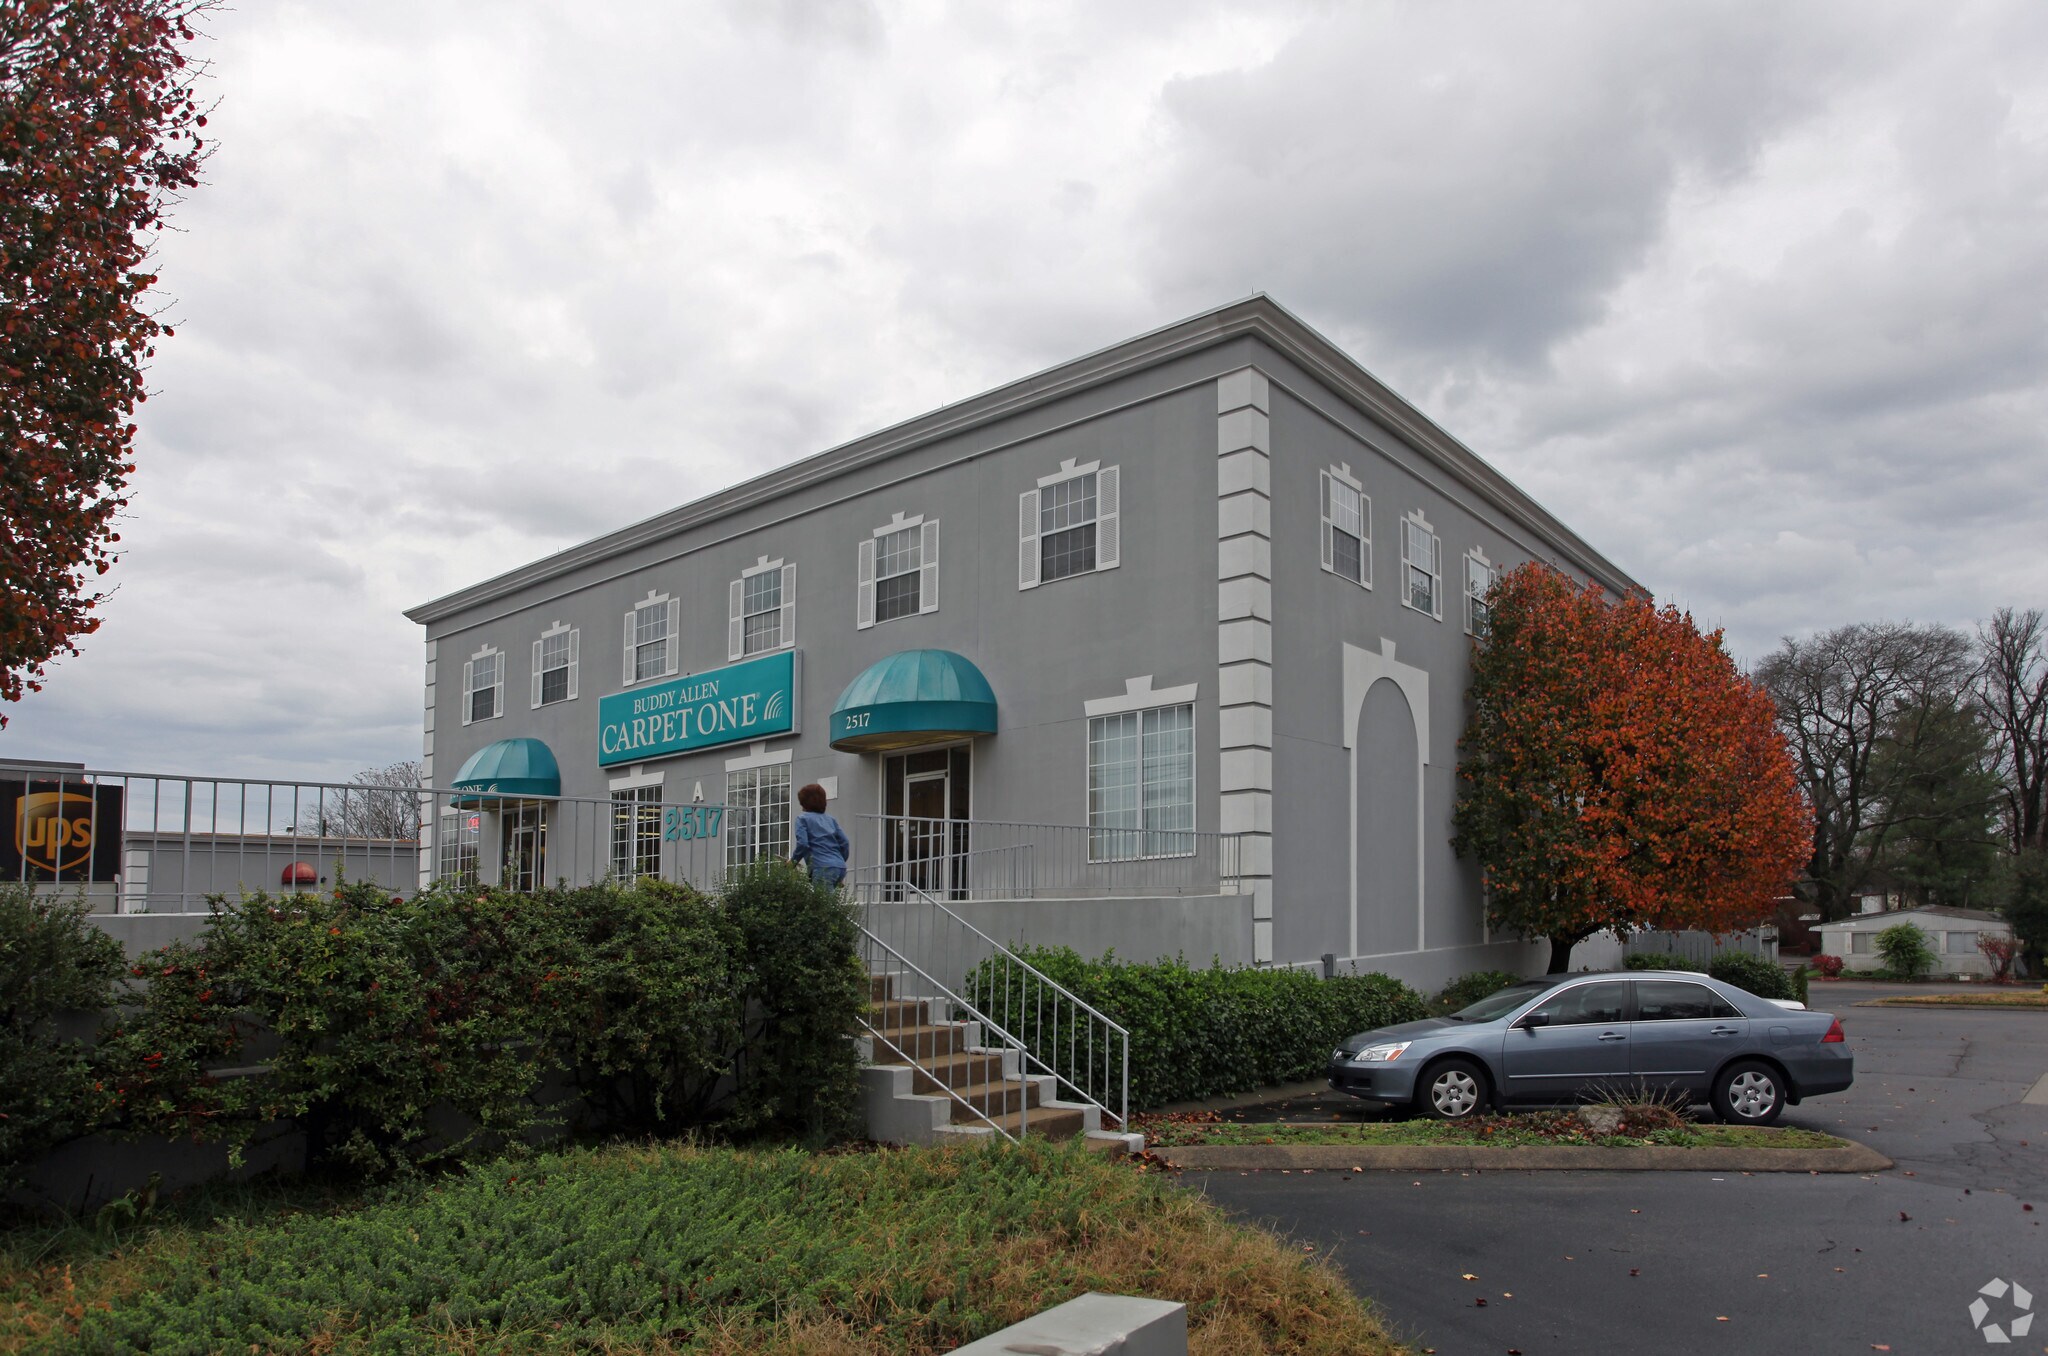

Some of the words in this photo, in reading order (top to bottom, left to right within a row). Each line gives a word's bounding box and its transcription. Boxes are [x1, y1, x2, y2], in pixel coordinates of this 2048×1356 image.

[633, 690, 676, 715] BUDDY
[678, 680, 720, 705] ALLEN
[602, 708, 693, 754] CARPET
[697, 693, 757, 735] ONE
[846, 713, 870, 730] 2517
[692, 781, 704, 802] A
[25, 816, 92, 859] ups
[665, 803, 724, 842] 2517
